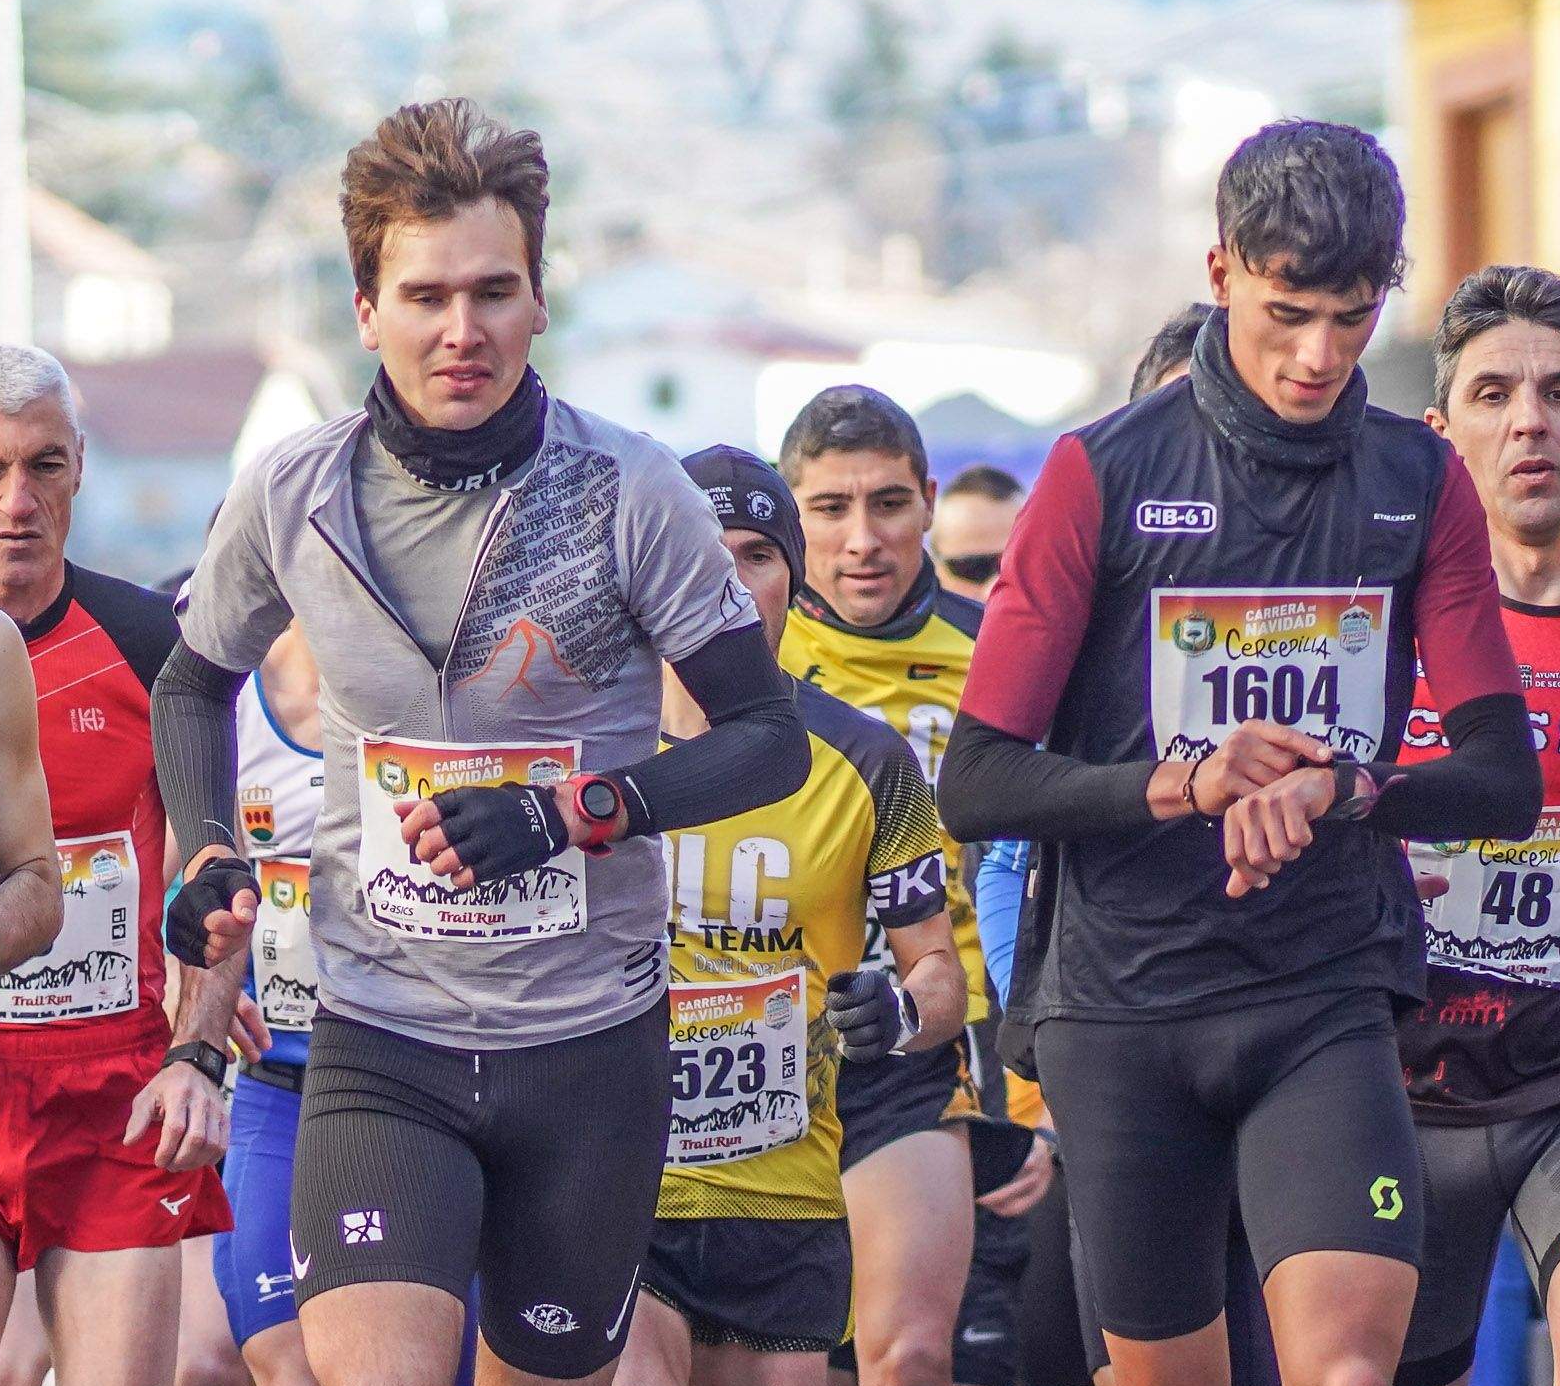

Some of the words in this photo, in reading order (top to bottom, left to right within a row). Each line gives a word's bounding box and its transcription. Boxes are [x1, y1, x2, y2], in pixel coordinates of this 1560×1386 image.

[1144, 507, 1210, 525] HB-61
[490, 560, 556, 599] MATTERHORN
[536, 550, 606, 593] MATTERHORN
[477, 584, 531, 611] ULTRAKS
[523, 576, 580, 609] ULTRAKS
[527, 589, 578, 620] TERHORN
[1245, 602, 1305, 622] CARRERA
[1244, 614, 1317, 638] NAVIDAD
[1202, 665, 1341, 726] 1604
[433, 755, 492, 772] CARRERA
[433, 765, 504, 787] NAVIDAD
[520, 798, 541, 833] GORE
[389, 904, 414, 916] asics
[1482, 870, 1554, 928] 48
[698, 924, 804, 953] TEAM
[677, 993, 734, 1012] CARRERA
[678, 1001, 745, 1025] NAVIDAD
